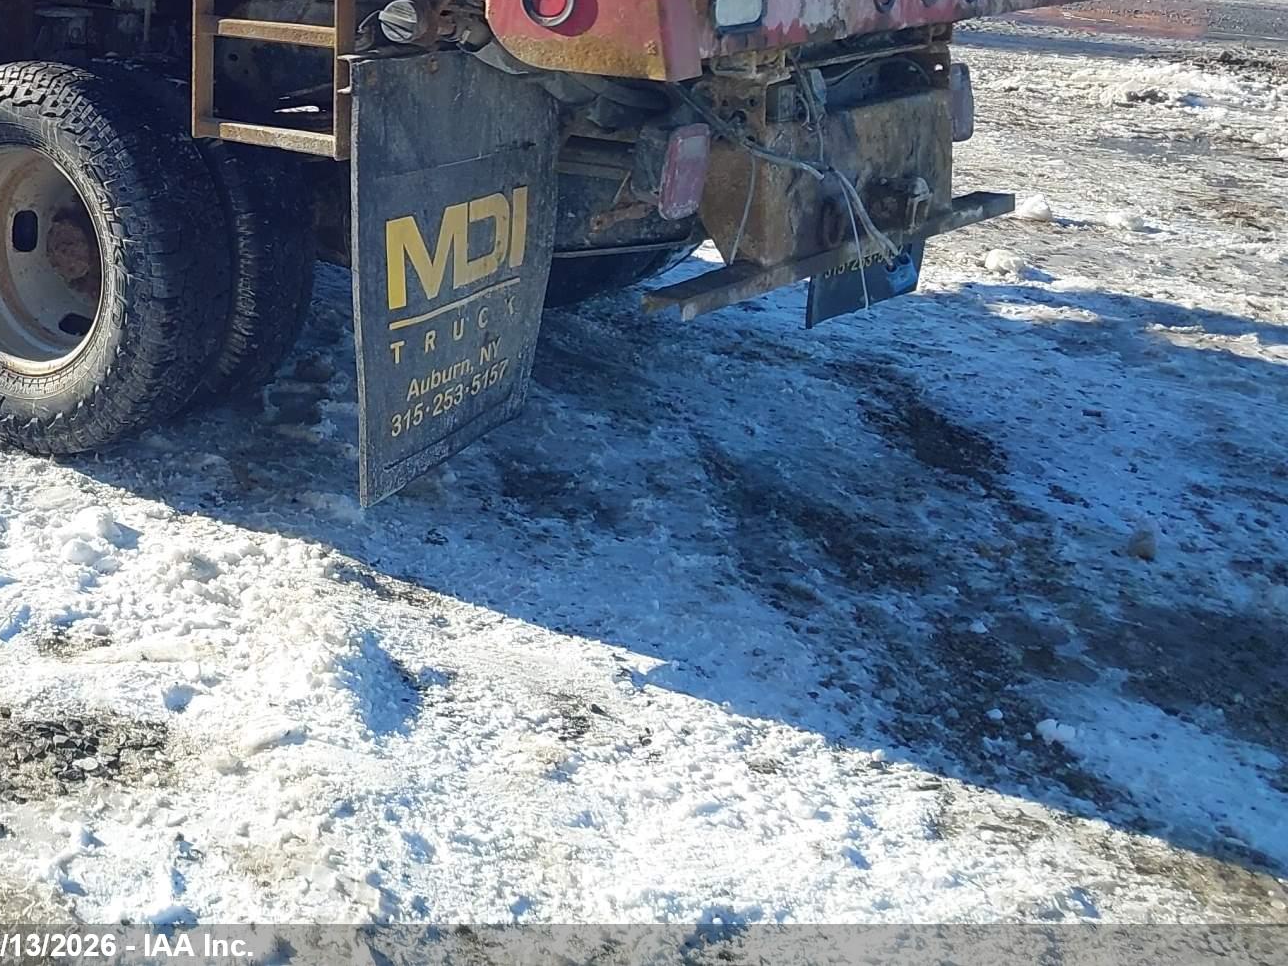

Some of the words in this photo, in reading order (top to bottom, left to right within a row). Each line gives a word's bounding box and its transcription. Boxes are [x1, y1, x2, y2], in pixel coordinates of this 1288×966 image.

[386, 186, 528, 310] MDI
[390, 296, 516, 365] TRUCK
[407, 359, 474, 402] Auburn,
[479, 337, 502, 366] NY
